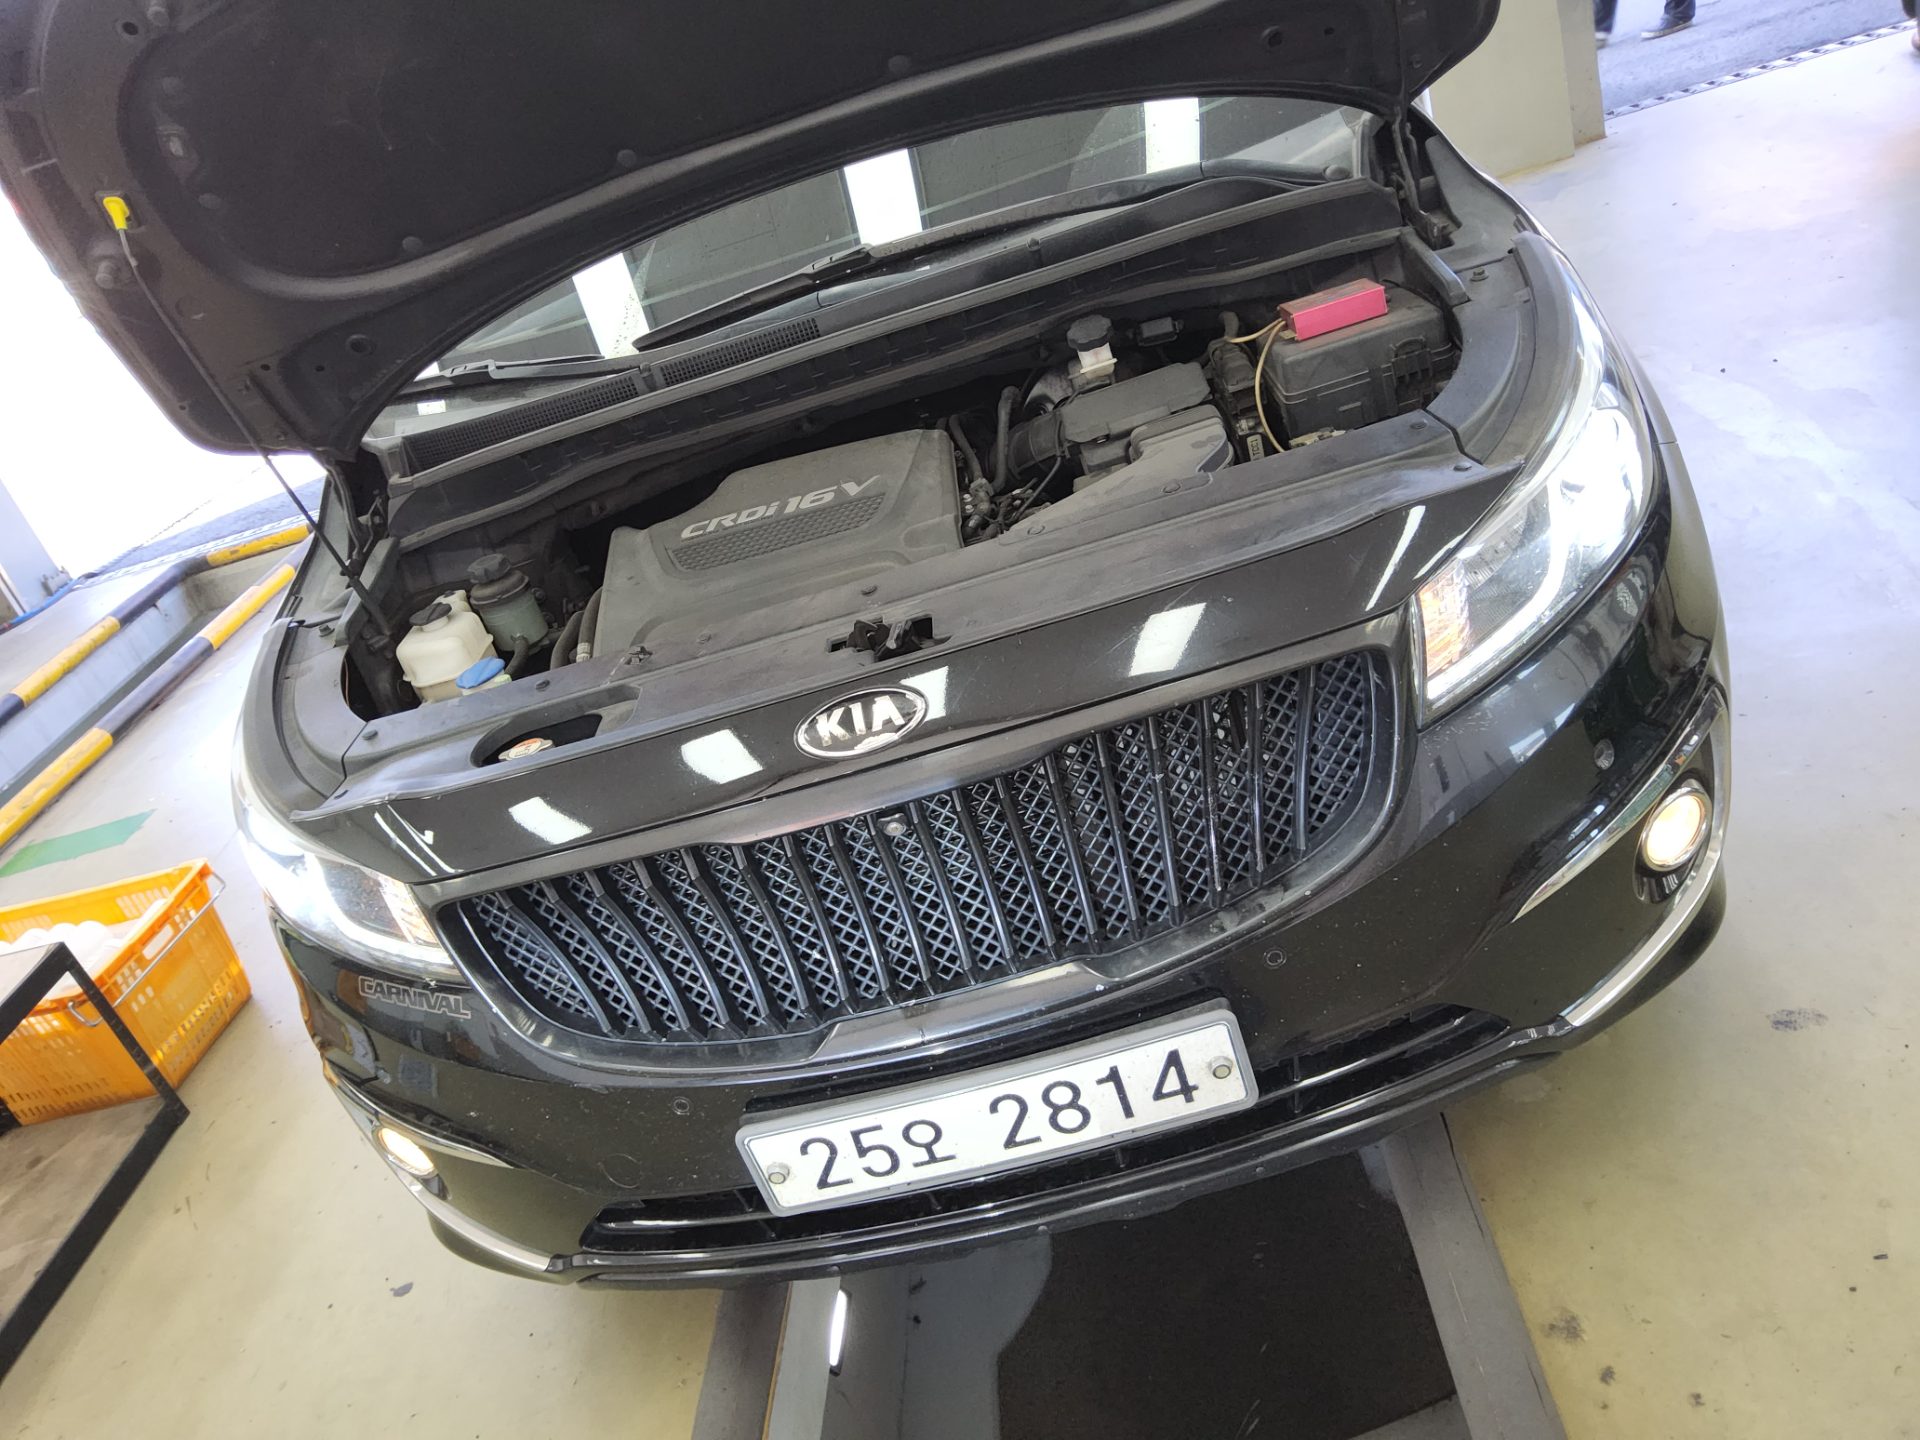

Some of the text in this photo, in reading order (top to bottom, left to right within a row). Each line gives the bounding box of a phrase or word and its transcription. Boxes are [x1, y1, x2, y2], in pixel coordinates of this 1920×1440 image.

[816, 695, 905, 747] KIA
[358, 975, 472, 1019] CARNIVAL
[799, 1048, 1200, 1190] 25오 2814
